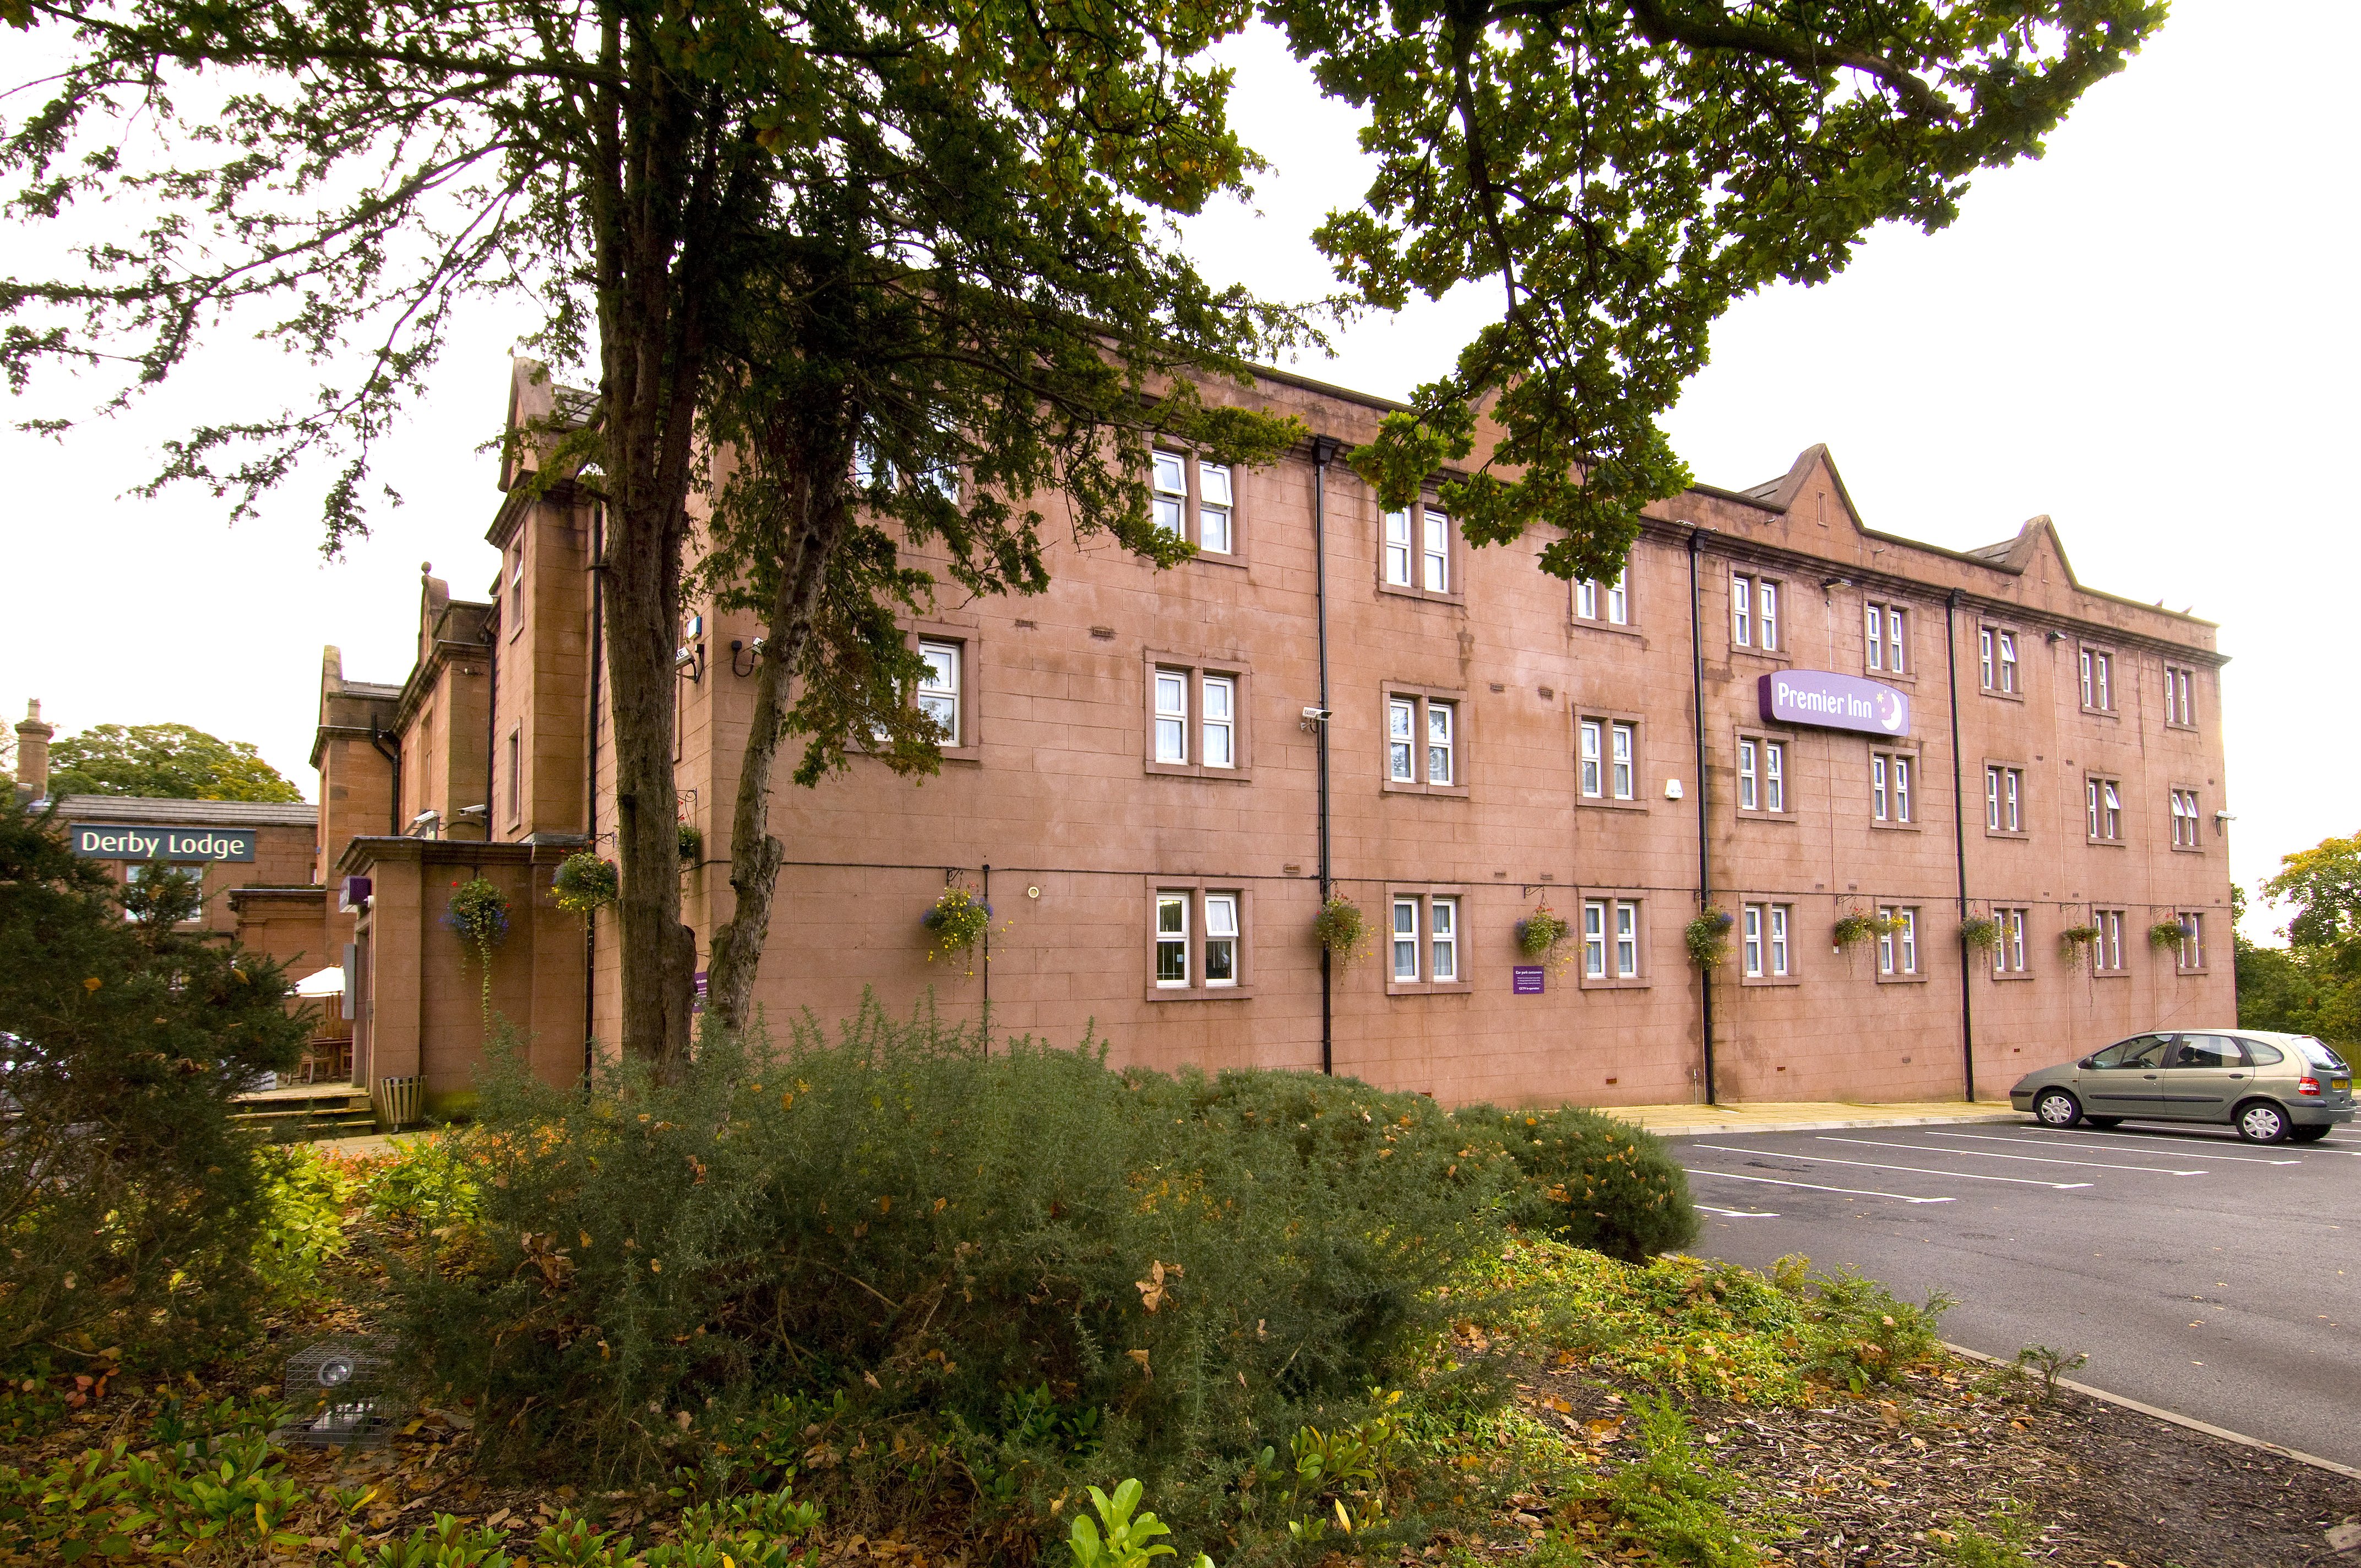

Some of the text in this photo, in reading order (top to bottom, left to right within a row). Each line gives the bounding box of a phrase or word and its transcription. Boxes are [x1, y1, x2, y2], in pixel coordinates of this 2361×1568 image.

[1778, 682, 1872, 718] Premier Inn
[81, 831, 245, 859] Derby Lodge
